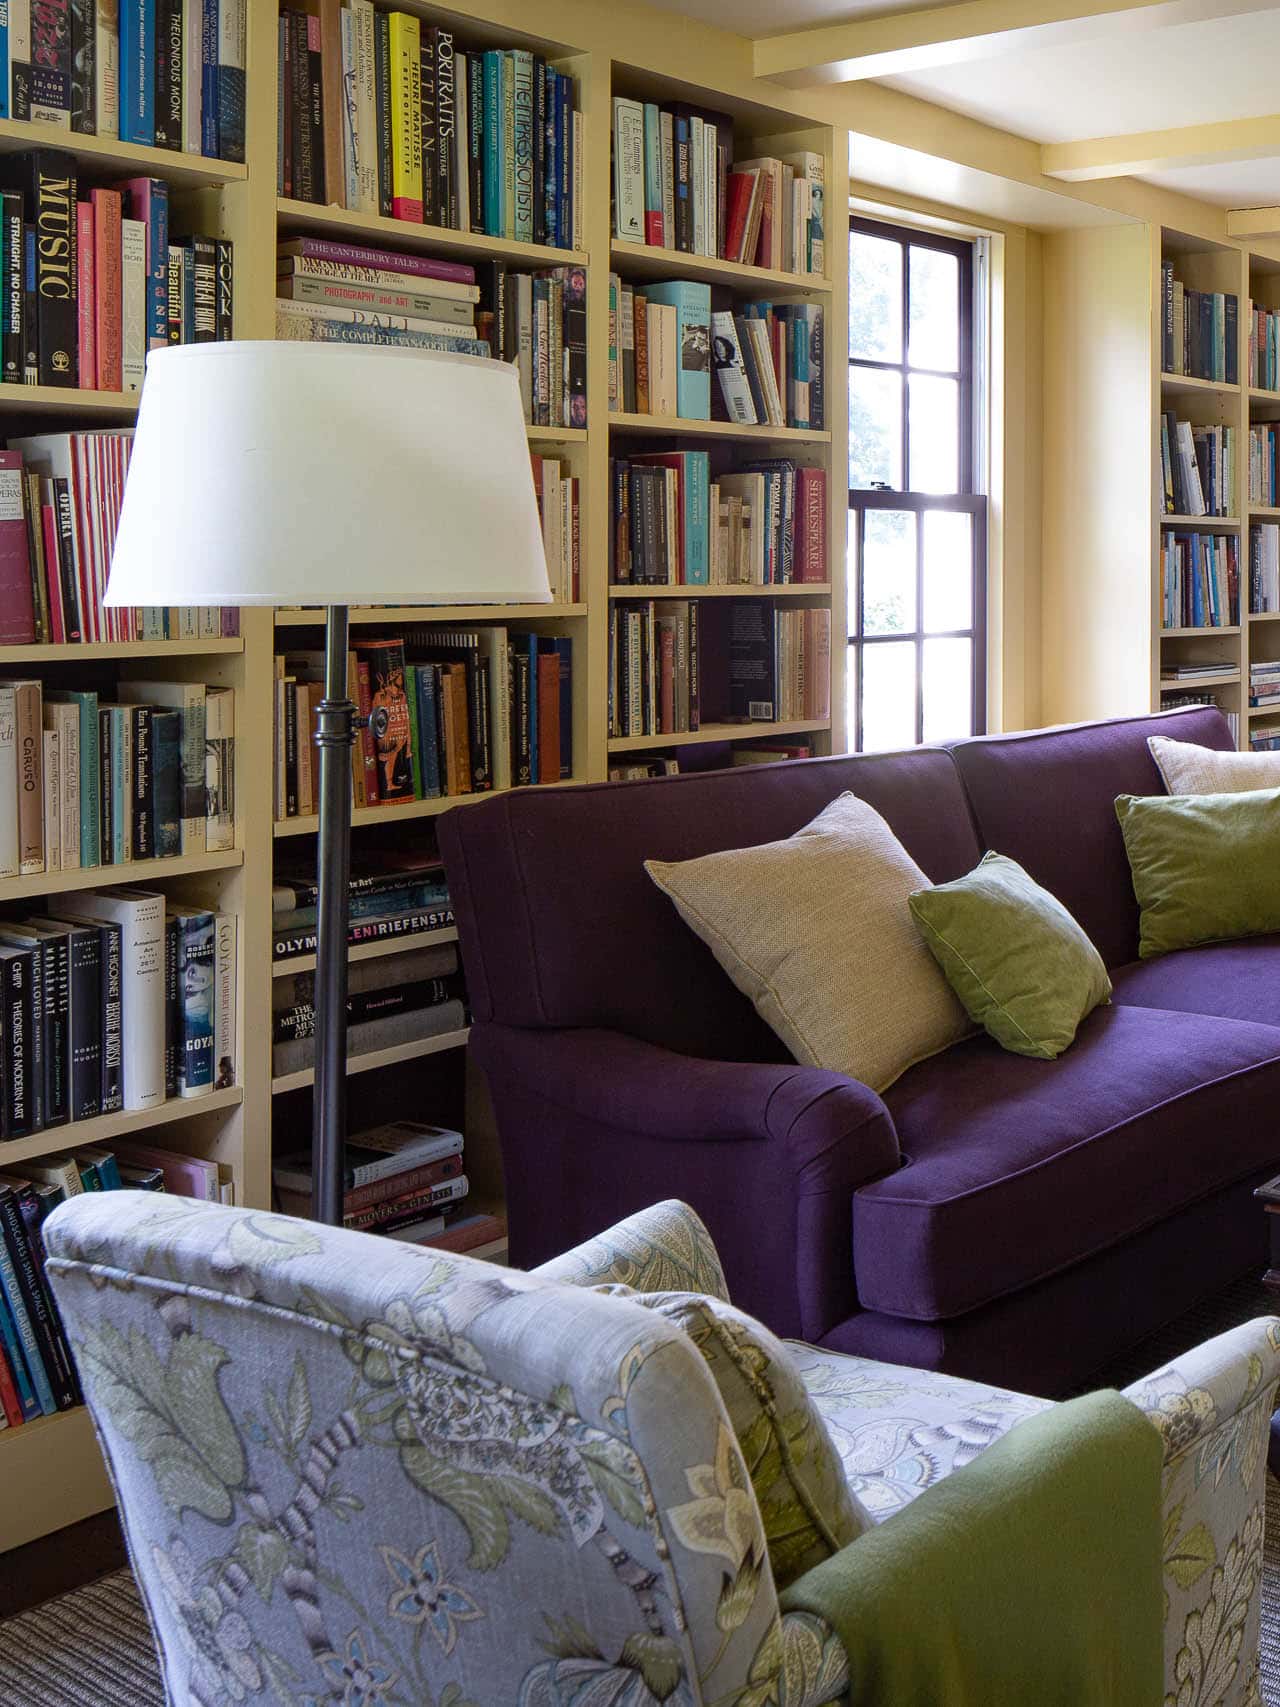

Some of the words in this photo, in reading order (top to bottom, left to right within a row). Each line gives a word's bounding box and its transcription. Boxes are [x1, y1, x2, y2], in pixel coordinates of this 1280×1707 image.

[170, 14, 181, 82] THELONIOUS
[170, 85, 181, 121] MONK
[412, 62, 420, 105] HENRI
[421, 45, 435, 153] TITIAN
[438, 31, 454, 138] PORTRAITS
[301, 113, 312, 201] RETROSPECTIVE
[413, 110, 421, 170] MATISSE
[10, 216, 21, 271] STRAIGHT,
[39, 173, 71, 300] MUSIC
[309, 243, 329, 254] THE
[330, 247, 390, 264] CANTERBURY
[393, 256, 419, 268] TALES
[11, 274, 20, 288] NO
[168, 262, 182, 321] beautiful
[195, 263, 216, 280] THE
[218, 245, 233, 317] MONK
[11, 292, 21, 334] CHASER
[324, 286, 376, 302] PHOTOGRAPHY
[195, 307, 216, 334] BOOK
[351, 311, 409, 331] DALI
[60, 493, 72, 538] OPERA
[809, 479, 819, 569] SHAKESPEARE
[139, 711, 148, 726] Ezra
[138, 728, 148, 754] Pound:
[24, 737, 35, 792] CARUSO
[138, 755, 149, 799] Translations
[109, 931, 120, 953] ANNE
[347, 925, 379, 941] ENI
[378, 911, 456, 935] RIEFENSTA
[32, 951, 42, 982] MUCH
[169, 932, 177, 1000] CARAVAGGIO
[219, 925, 233, 974] GOYA
[12, 962, 23, 988] CHIPP
[109, 954, 120, 999] HIGONNET
[33, 984, 42, 1019] LOVED
[105, 1001, 120, 1033] BERTHE
[13, 1000, 24, 1047] THEORIES
[186, 1036, 214, 1051] GOYA
[14, 1048, 24, 1059] OF
[105, 1034, 120, 1068] MORISOT
[14, 1060, 24, 1101] MODERN
[15, 1102, 25, 1121] ART
[6, 1202, 29, 1257] LANDSCAPES
[21, 1261, 39, 1289] SMALL
[28, 1290, 48, 1322] SPACES
[12, 1307, 37, 1354] GARDEN
